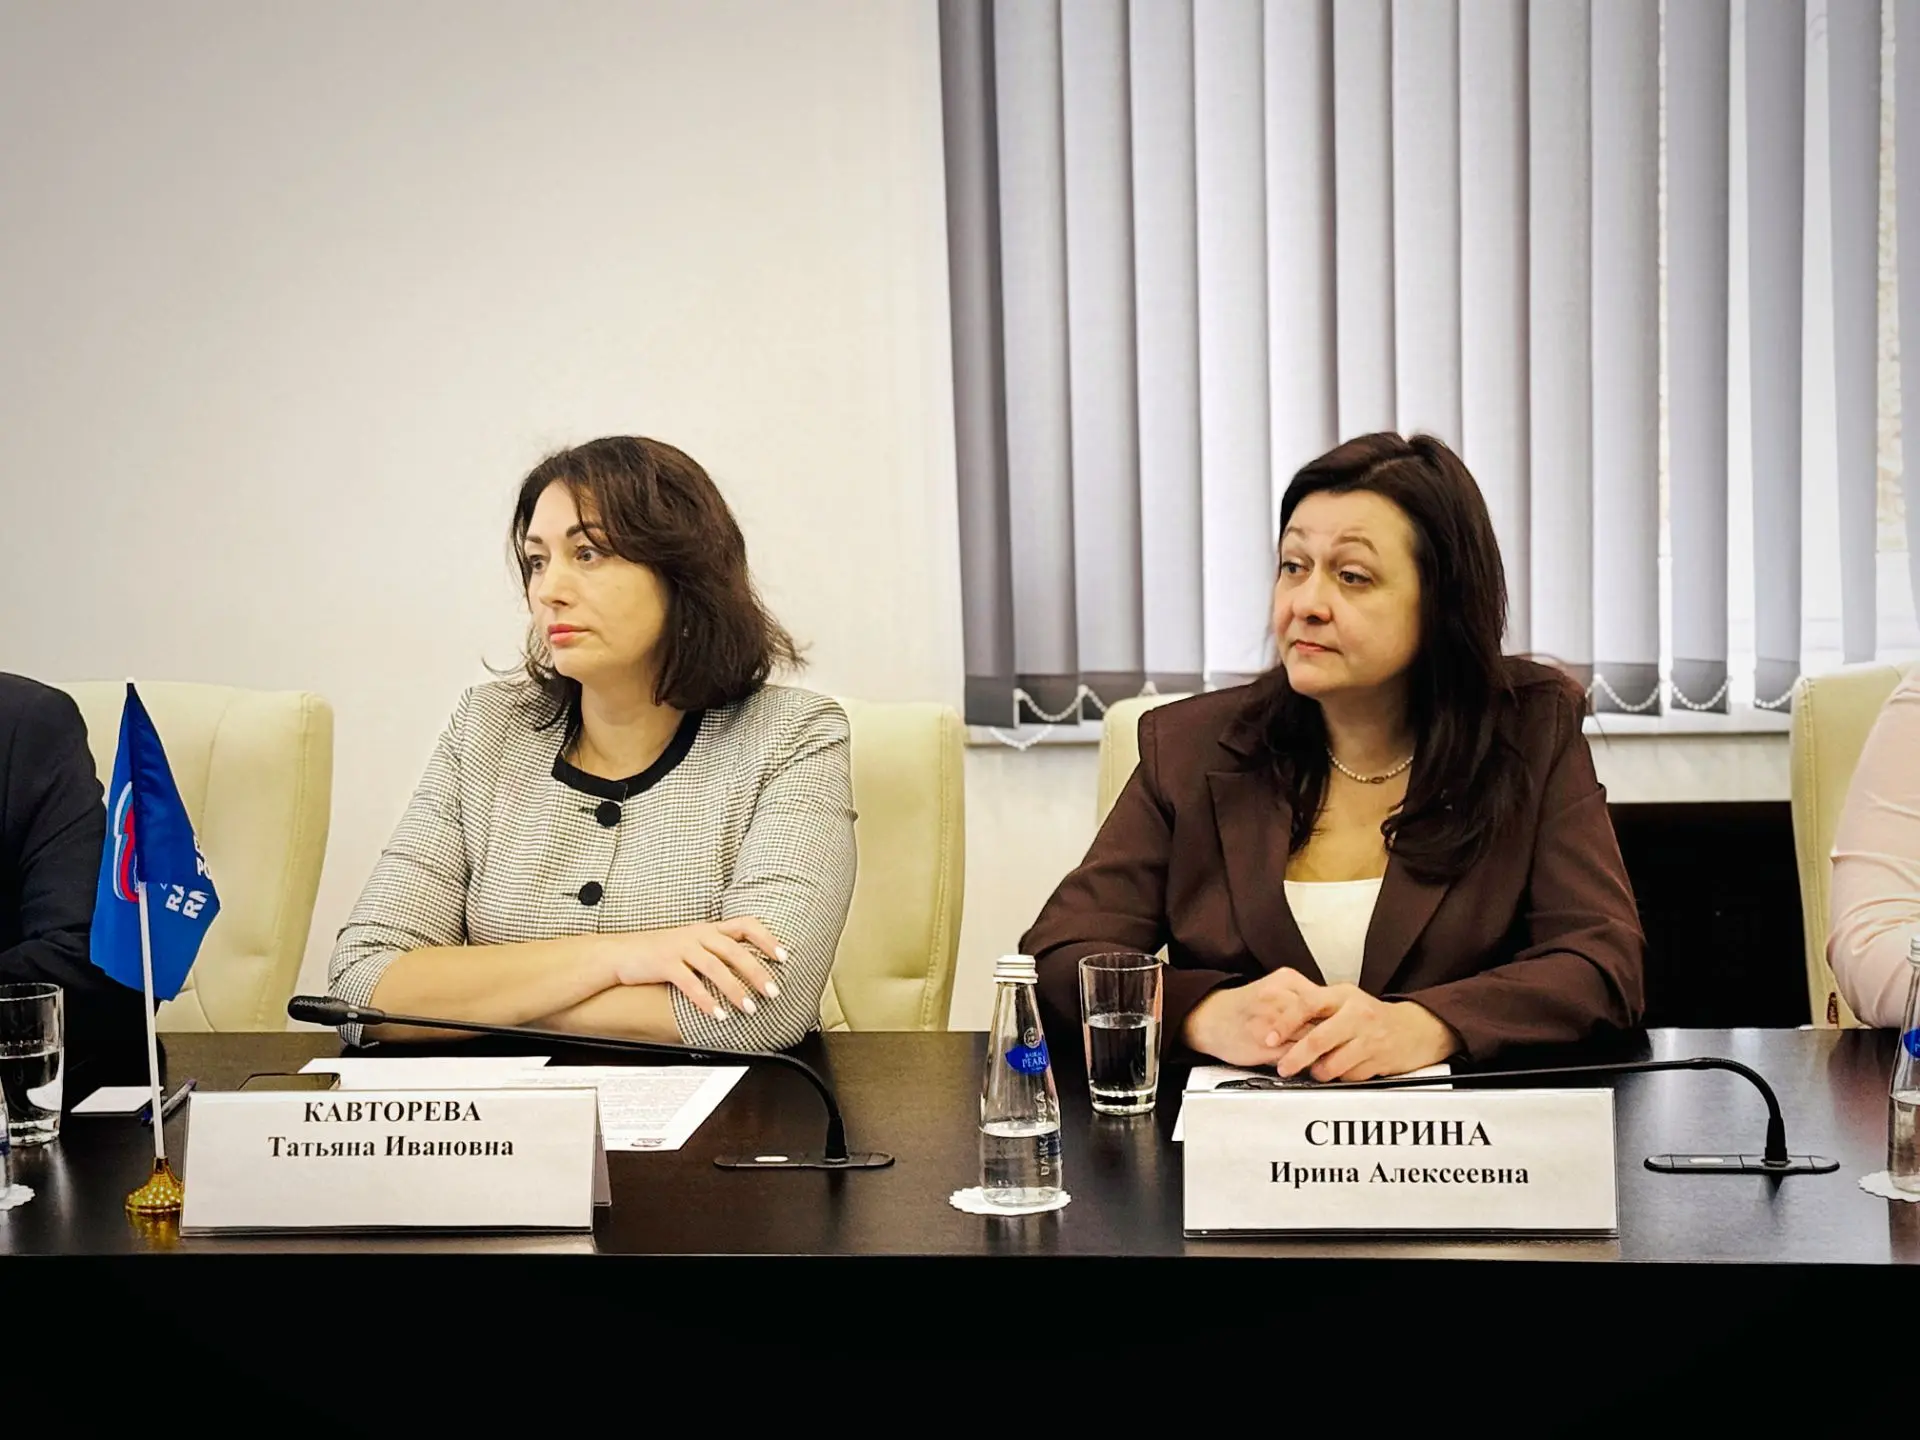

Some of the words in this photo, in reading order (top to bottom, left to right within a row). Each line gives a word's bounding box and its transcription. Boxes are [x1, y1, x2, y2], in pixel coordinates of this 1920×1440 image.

[1021, 1055, 1047, 1068] PEARL
[304, 1101, 482, 1122] КАВТОРЕВА
[1304, 1119, 1492, 1146] СПИРИНА
[268, 1136, 376, 1157] Татьяна
[384, 1135, 514, 1157] Ивановна
[1270, 1161, 1360, 1188] Ирина
[1368, 1162, 1530, 1184] Алексеевна
